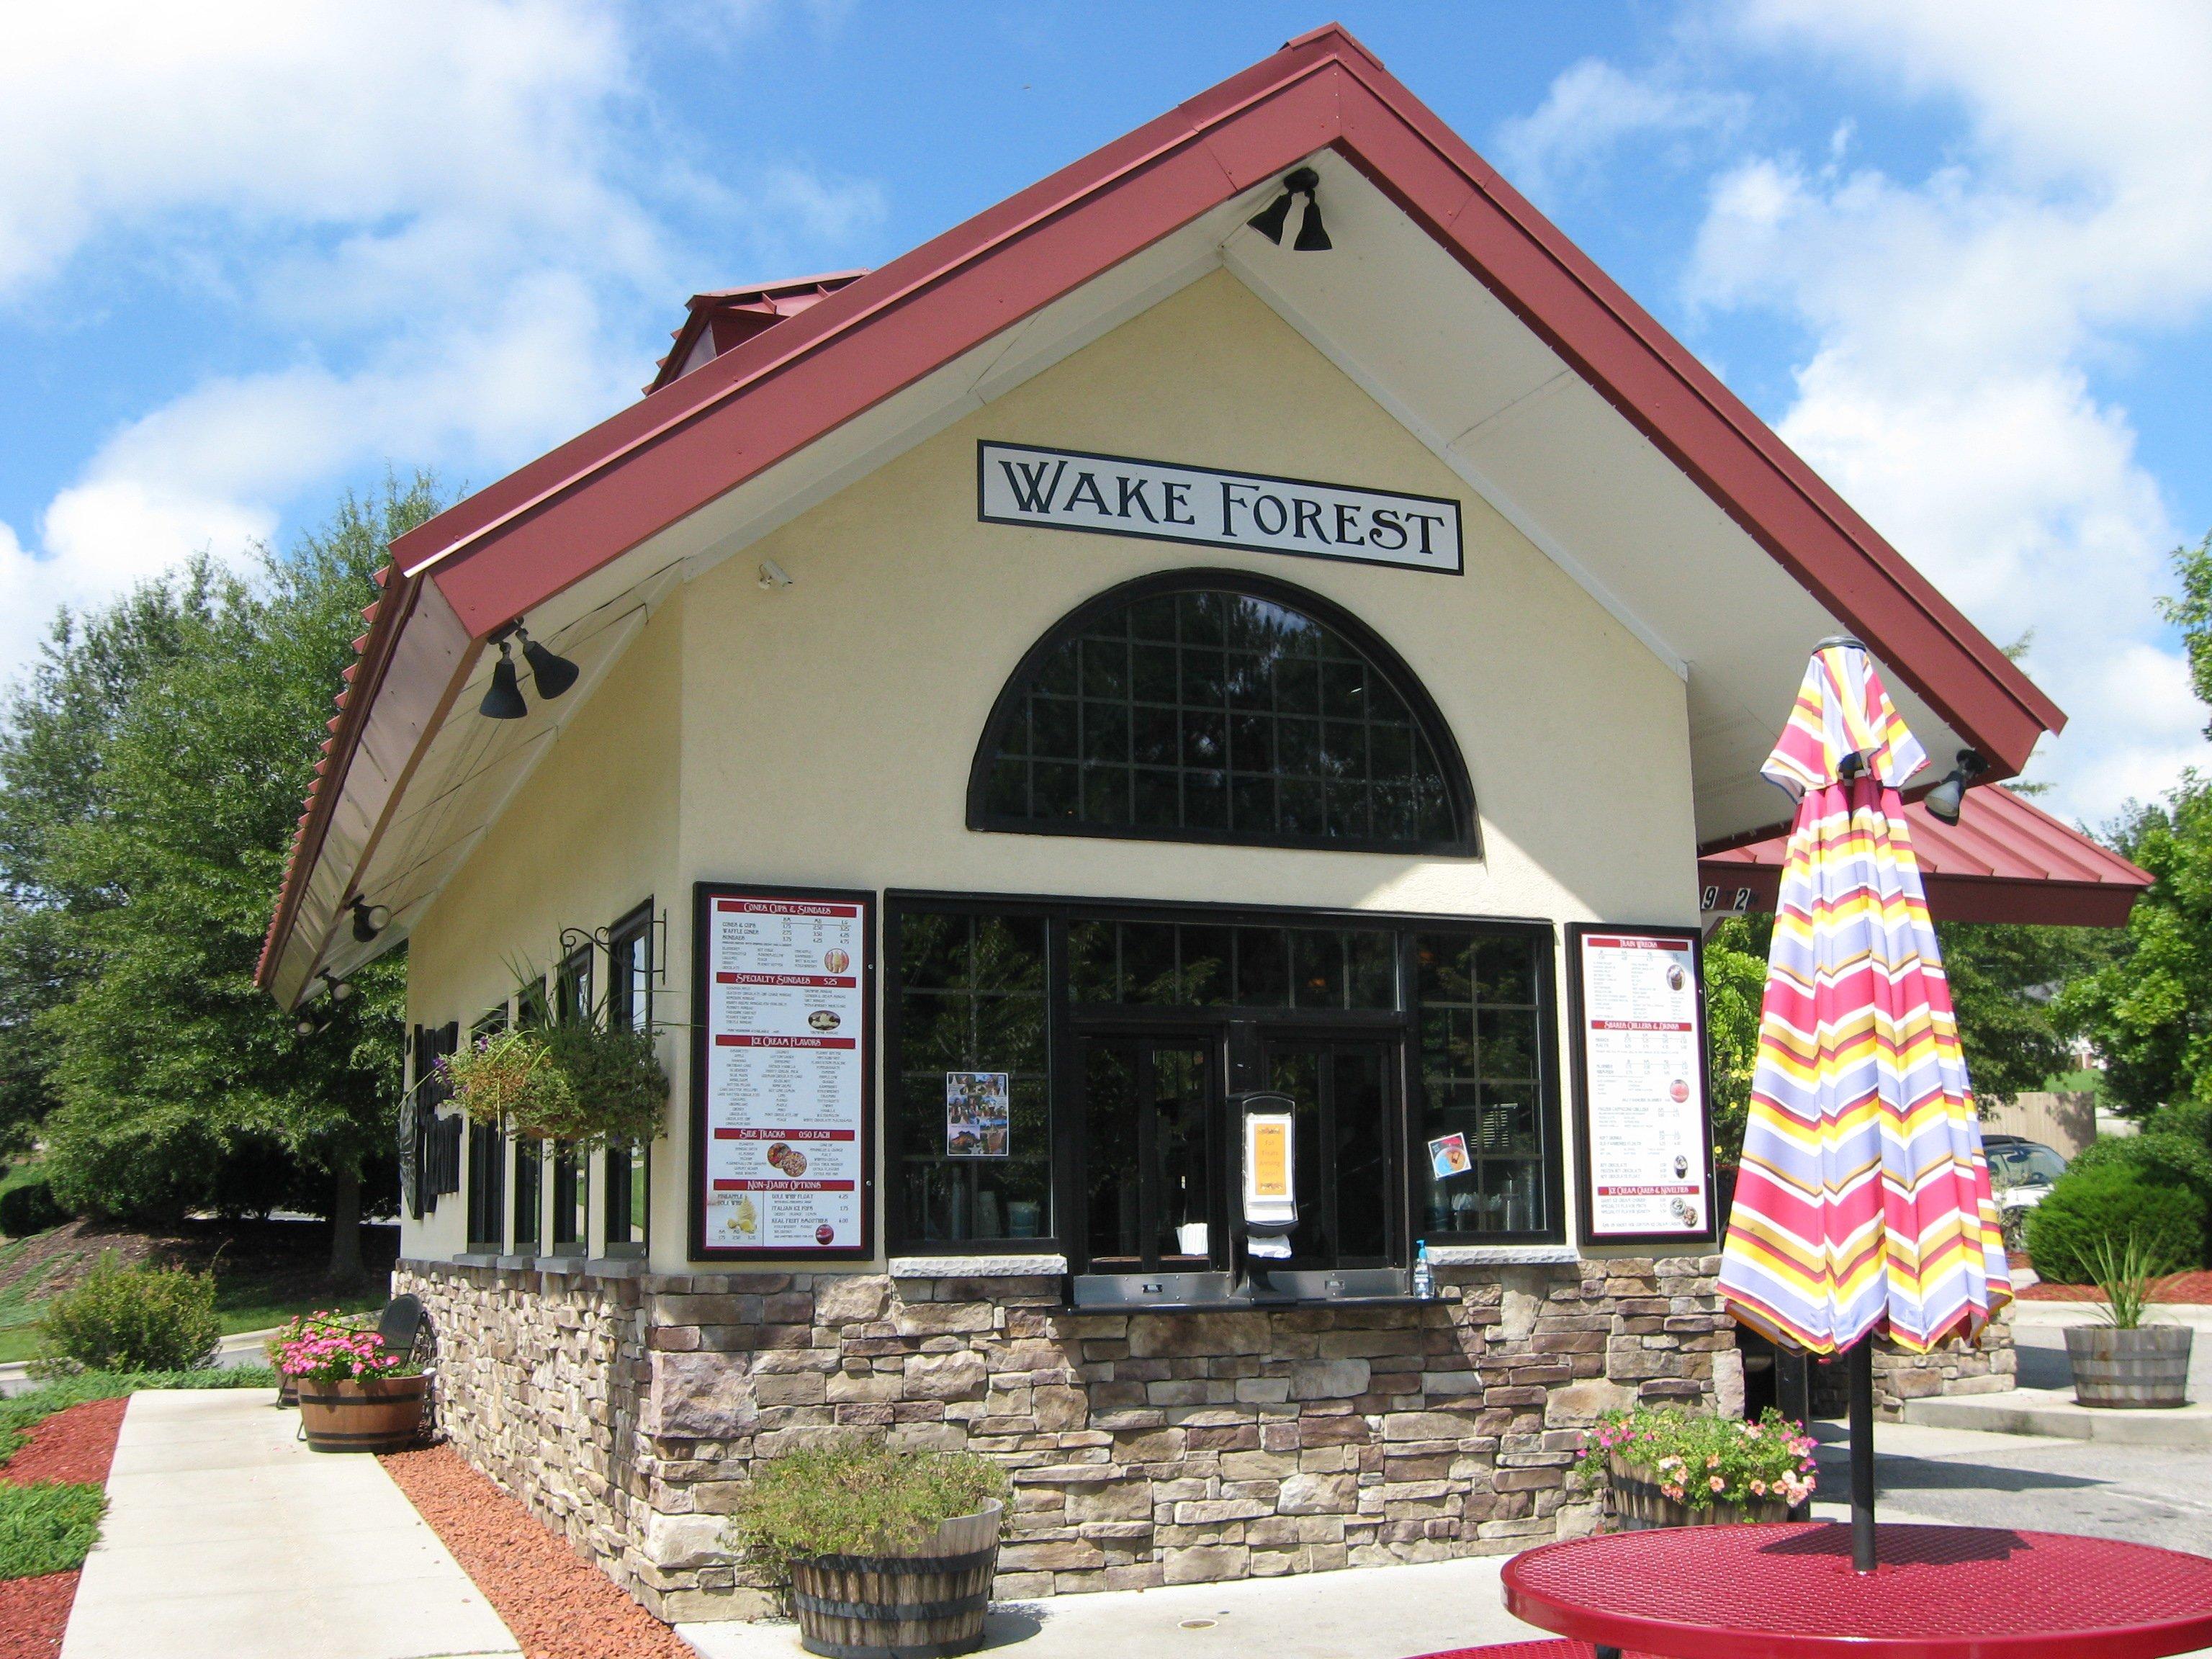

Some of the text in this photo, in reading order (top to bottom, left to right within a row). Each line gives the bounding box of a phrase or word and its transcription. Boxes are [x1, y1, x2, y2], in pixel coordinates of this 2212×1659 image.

[998, 460, 1445, 555] WAKE FOREST
[1704, 886, 1716, 909] 9
[1735, 889, 1748, 910] 2
[797, 905, 832, 915] SUNDAES
[736, 974, 775, 984] SPECIALTY
[776, 976, 811, 985] SUNDAES
[751, 1036, 821, 1047] ICE CREAM FLAVORS
[739, 1130, 757, 1139] SIDE
[758, 1129, 785, 1139] TRACKS
[747, 1180, 822, 1191] NON-DAIRY OPTIONS
